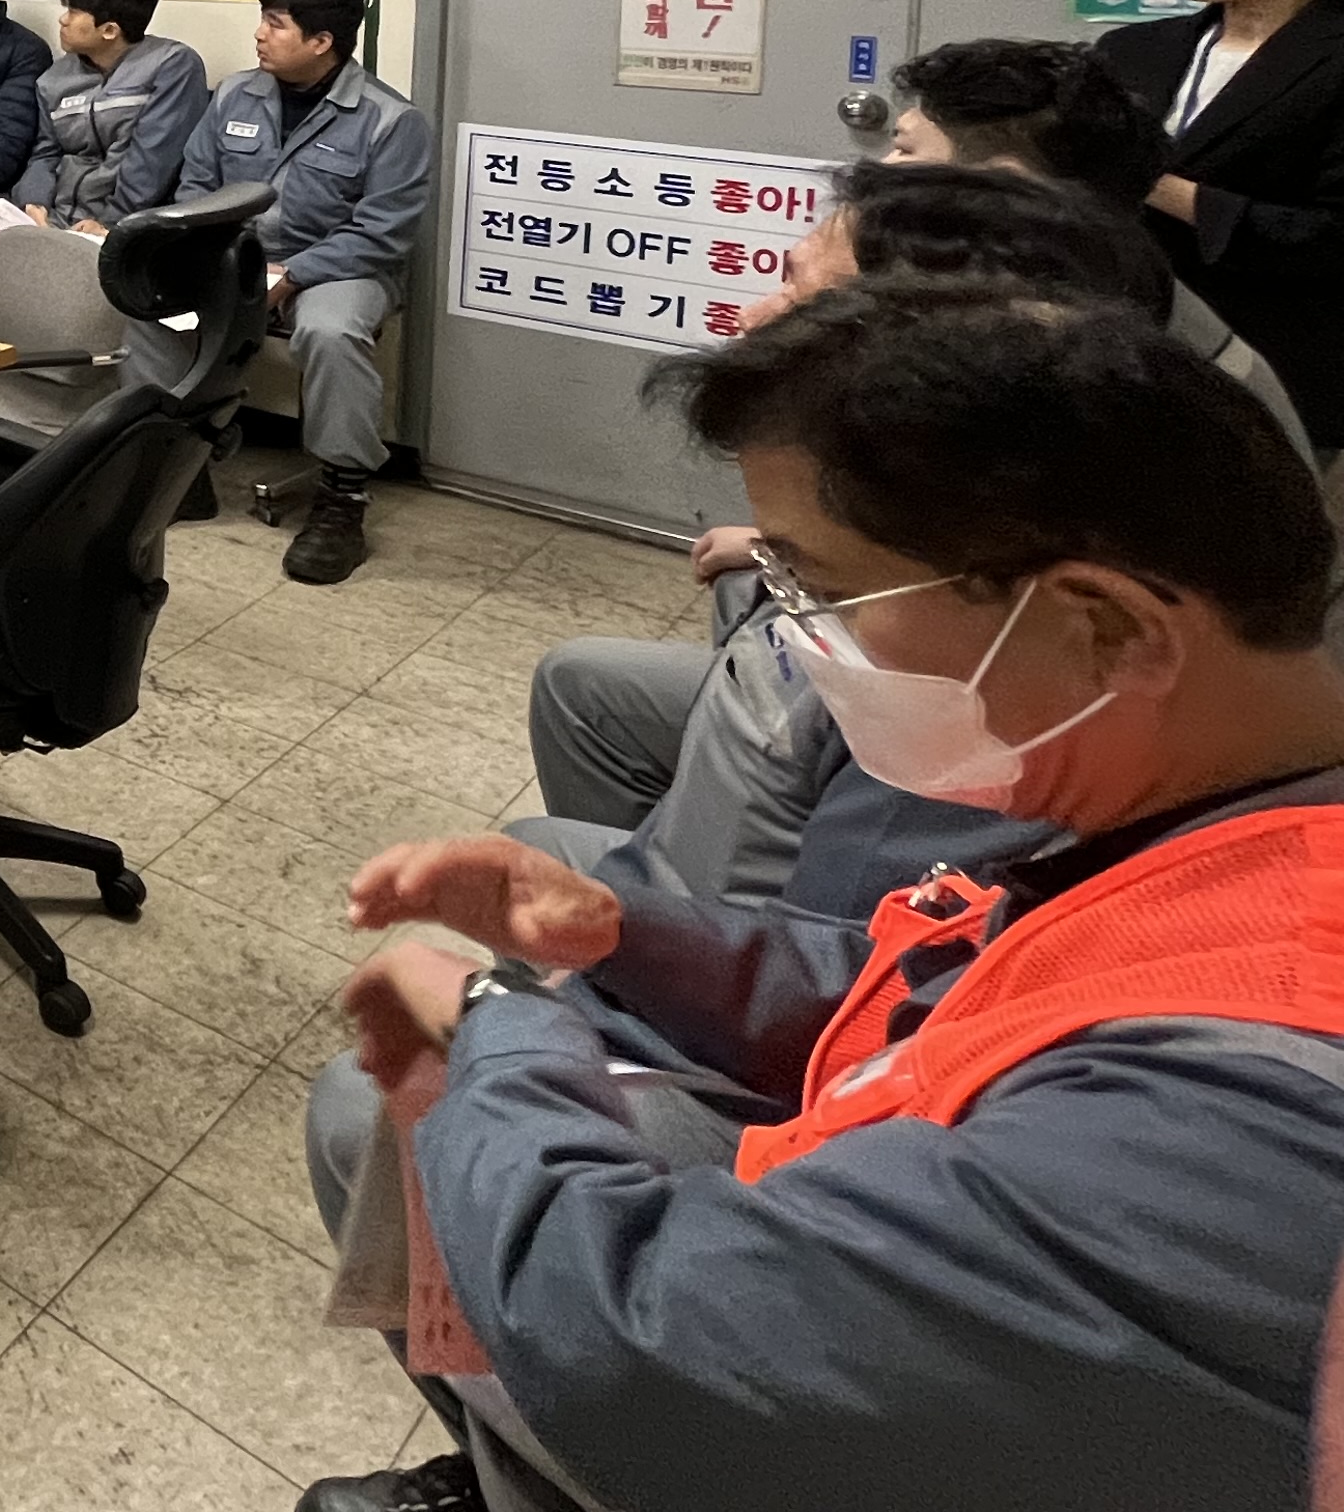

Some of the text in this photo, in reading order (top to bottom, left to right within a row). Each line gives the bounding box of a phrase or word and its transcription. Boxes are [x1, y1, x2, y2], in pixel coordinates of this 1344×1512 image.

[711, 178, 817, 223] 좋아!
[480, 209, 592, 254] 전열기
[606, 228, 692, 265] OFF
